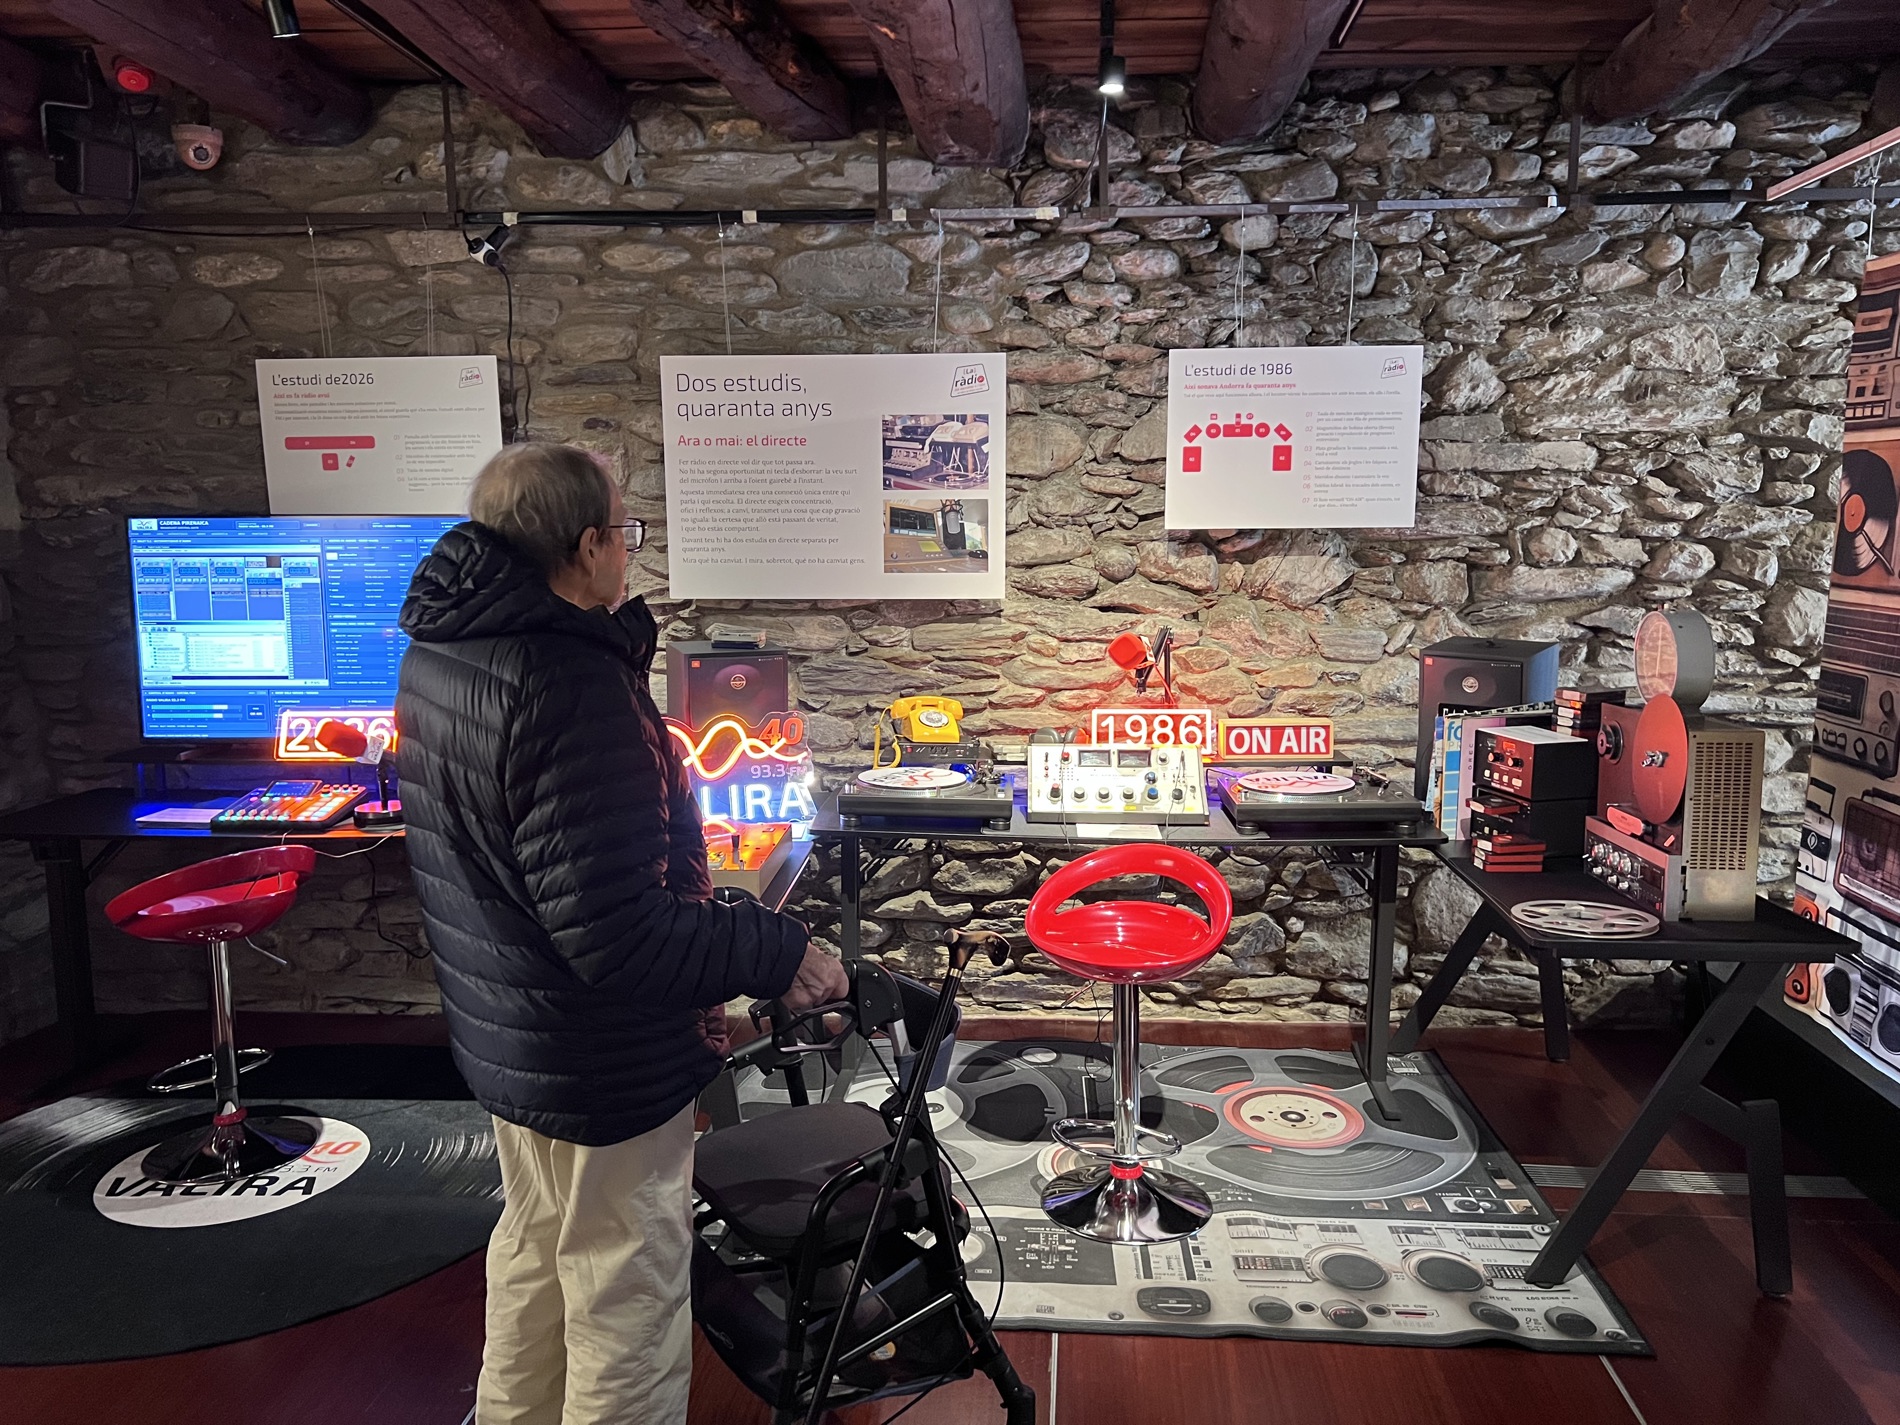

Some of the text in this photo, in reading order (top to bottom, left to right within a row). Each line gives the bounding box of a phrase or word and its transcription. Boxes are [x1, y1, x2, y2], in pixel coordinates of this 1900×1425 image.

[1185, 363, 1293, 376] L'estudi de 1986
[272, 374, 322, 386] L'estudi
[676, 373, 808, 394] Dos estudis,
[677, 401, 832, 421] quaranta anys
[678, 435, 807, 446] Ara o mai: el directe
[729, 467, 765, 476] oportunitat
[681, 488, 704, 497] Aquesta
[840, 488, 850, 497] qui
[680, 497, 696, 506] parla
[700, 497, 711, 506] qui
[767, 497, 790, 506] exigeix
[782, 515, 806, 524] passant
[801, 536, 827, 545] separats
[682, 545, 709, 554] quaranta
[759, 718, 803, 745] 40
[1100, 714, 1202, 745] 1986
[1228, 727, 1327, 754] ON AIR
[751, 764, 785, 778] 93.3
[701, 782, 810, 820] LIRA
[278, 1164, 312, 1174] 3.3
[105, 1176, 317, 1196] VALIRA
